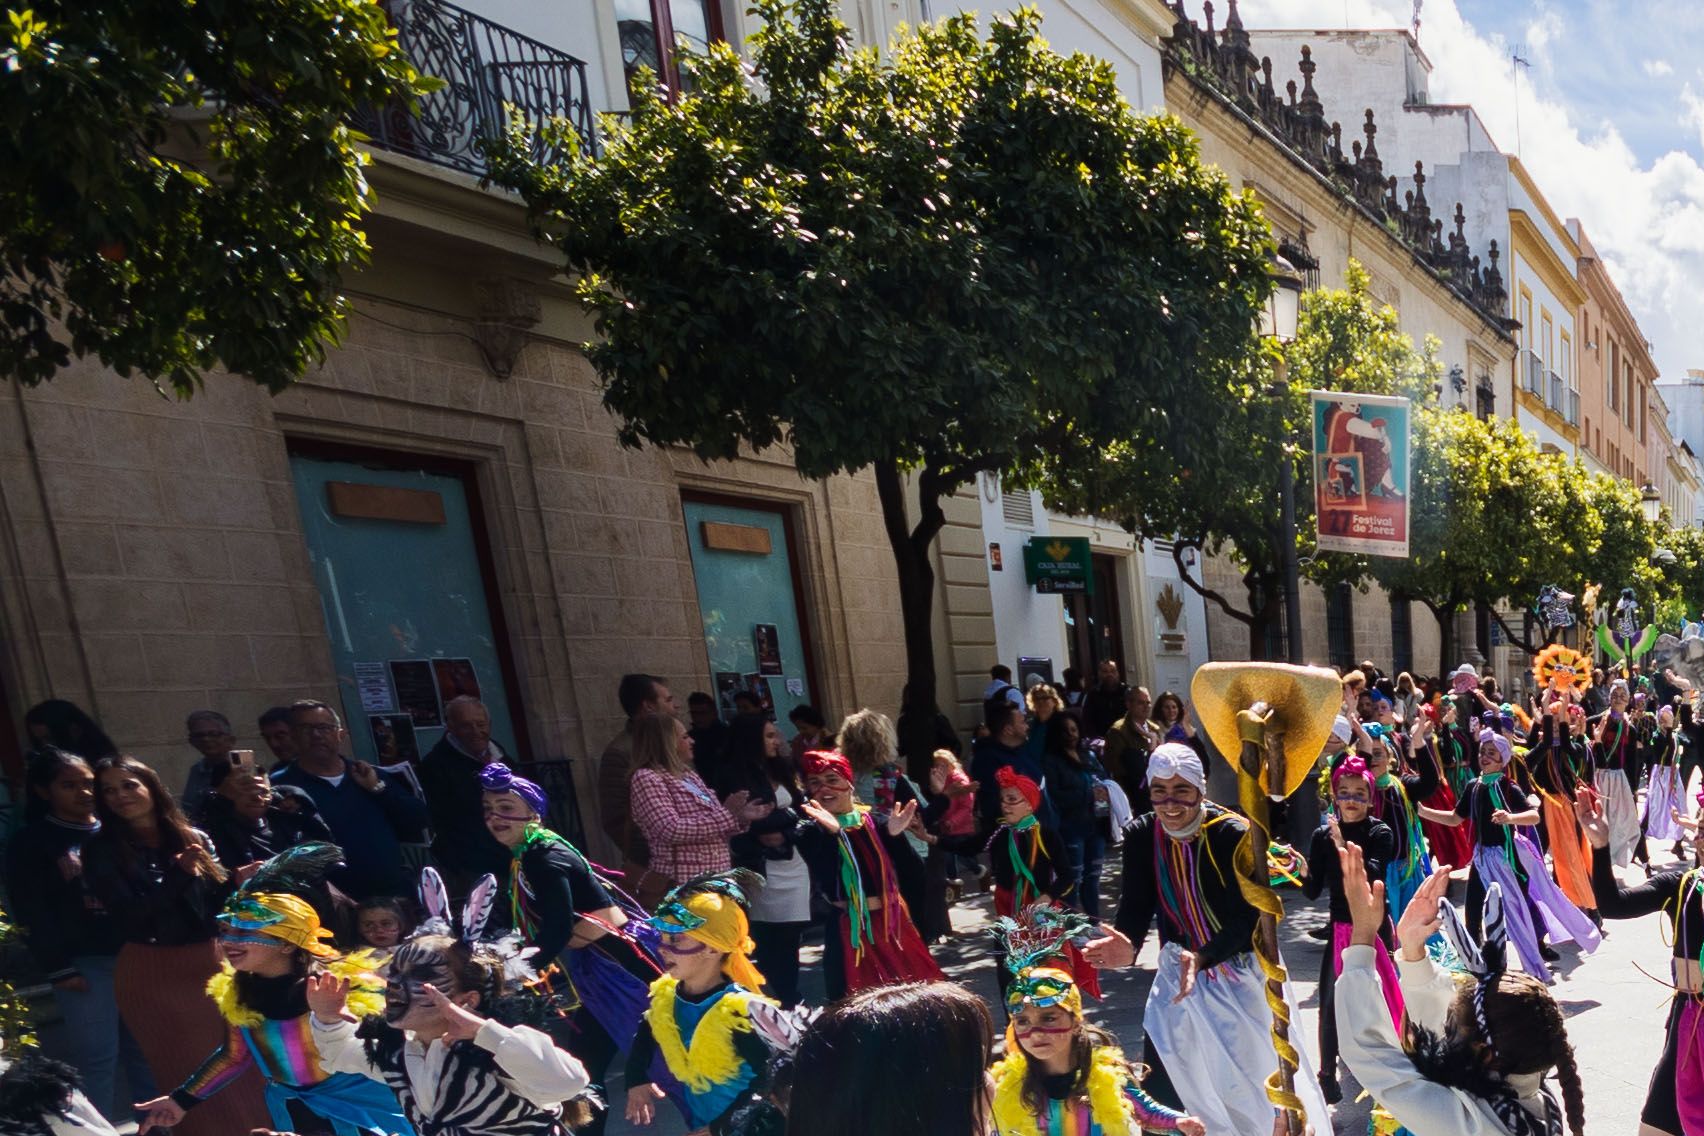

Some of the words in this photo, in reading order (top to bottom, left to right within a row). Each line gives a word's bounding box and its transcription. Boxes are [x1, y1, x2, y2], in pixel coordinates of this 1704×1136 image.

[1352, 514, 1393, 527] Festival
[1352, 524, 1366, 534] de
[1368, 525, 1396, 536] Jerez
